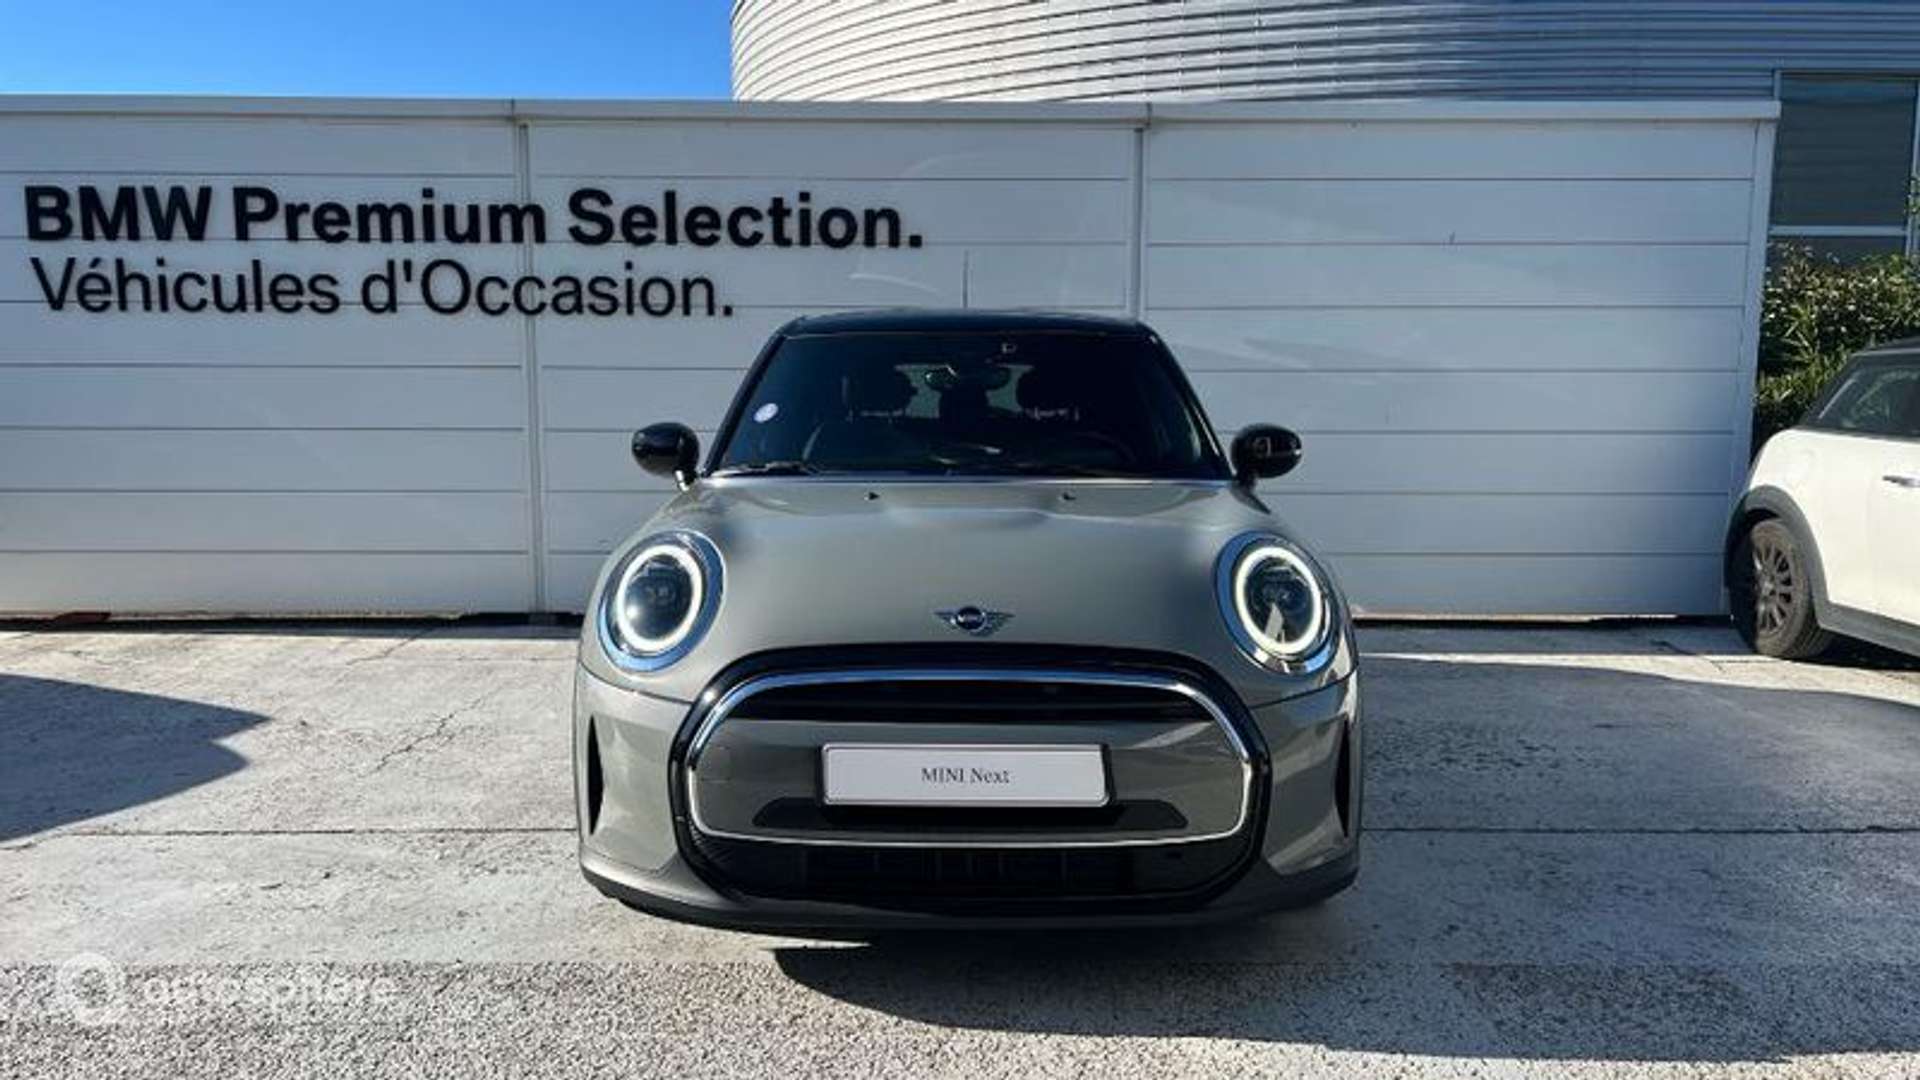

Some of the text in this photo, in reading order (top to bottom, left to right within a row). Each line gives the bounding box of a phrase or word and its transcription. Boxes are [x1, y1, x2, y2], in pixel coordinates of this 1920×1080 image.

[25, 185, 923, 248] BMW Premium Selection.
[30, 256, 733, 316] Véhicules d'Occasion.
[921, 767, 1011, 783] MINI Next
